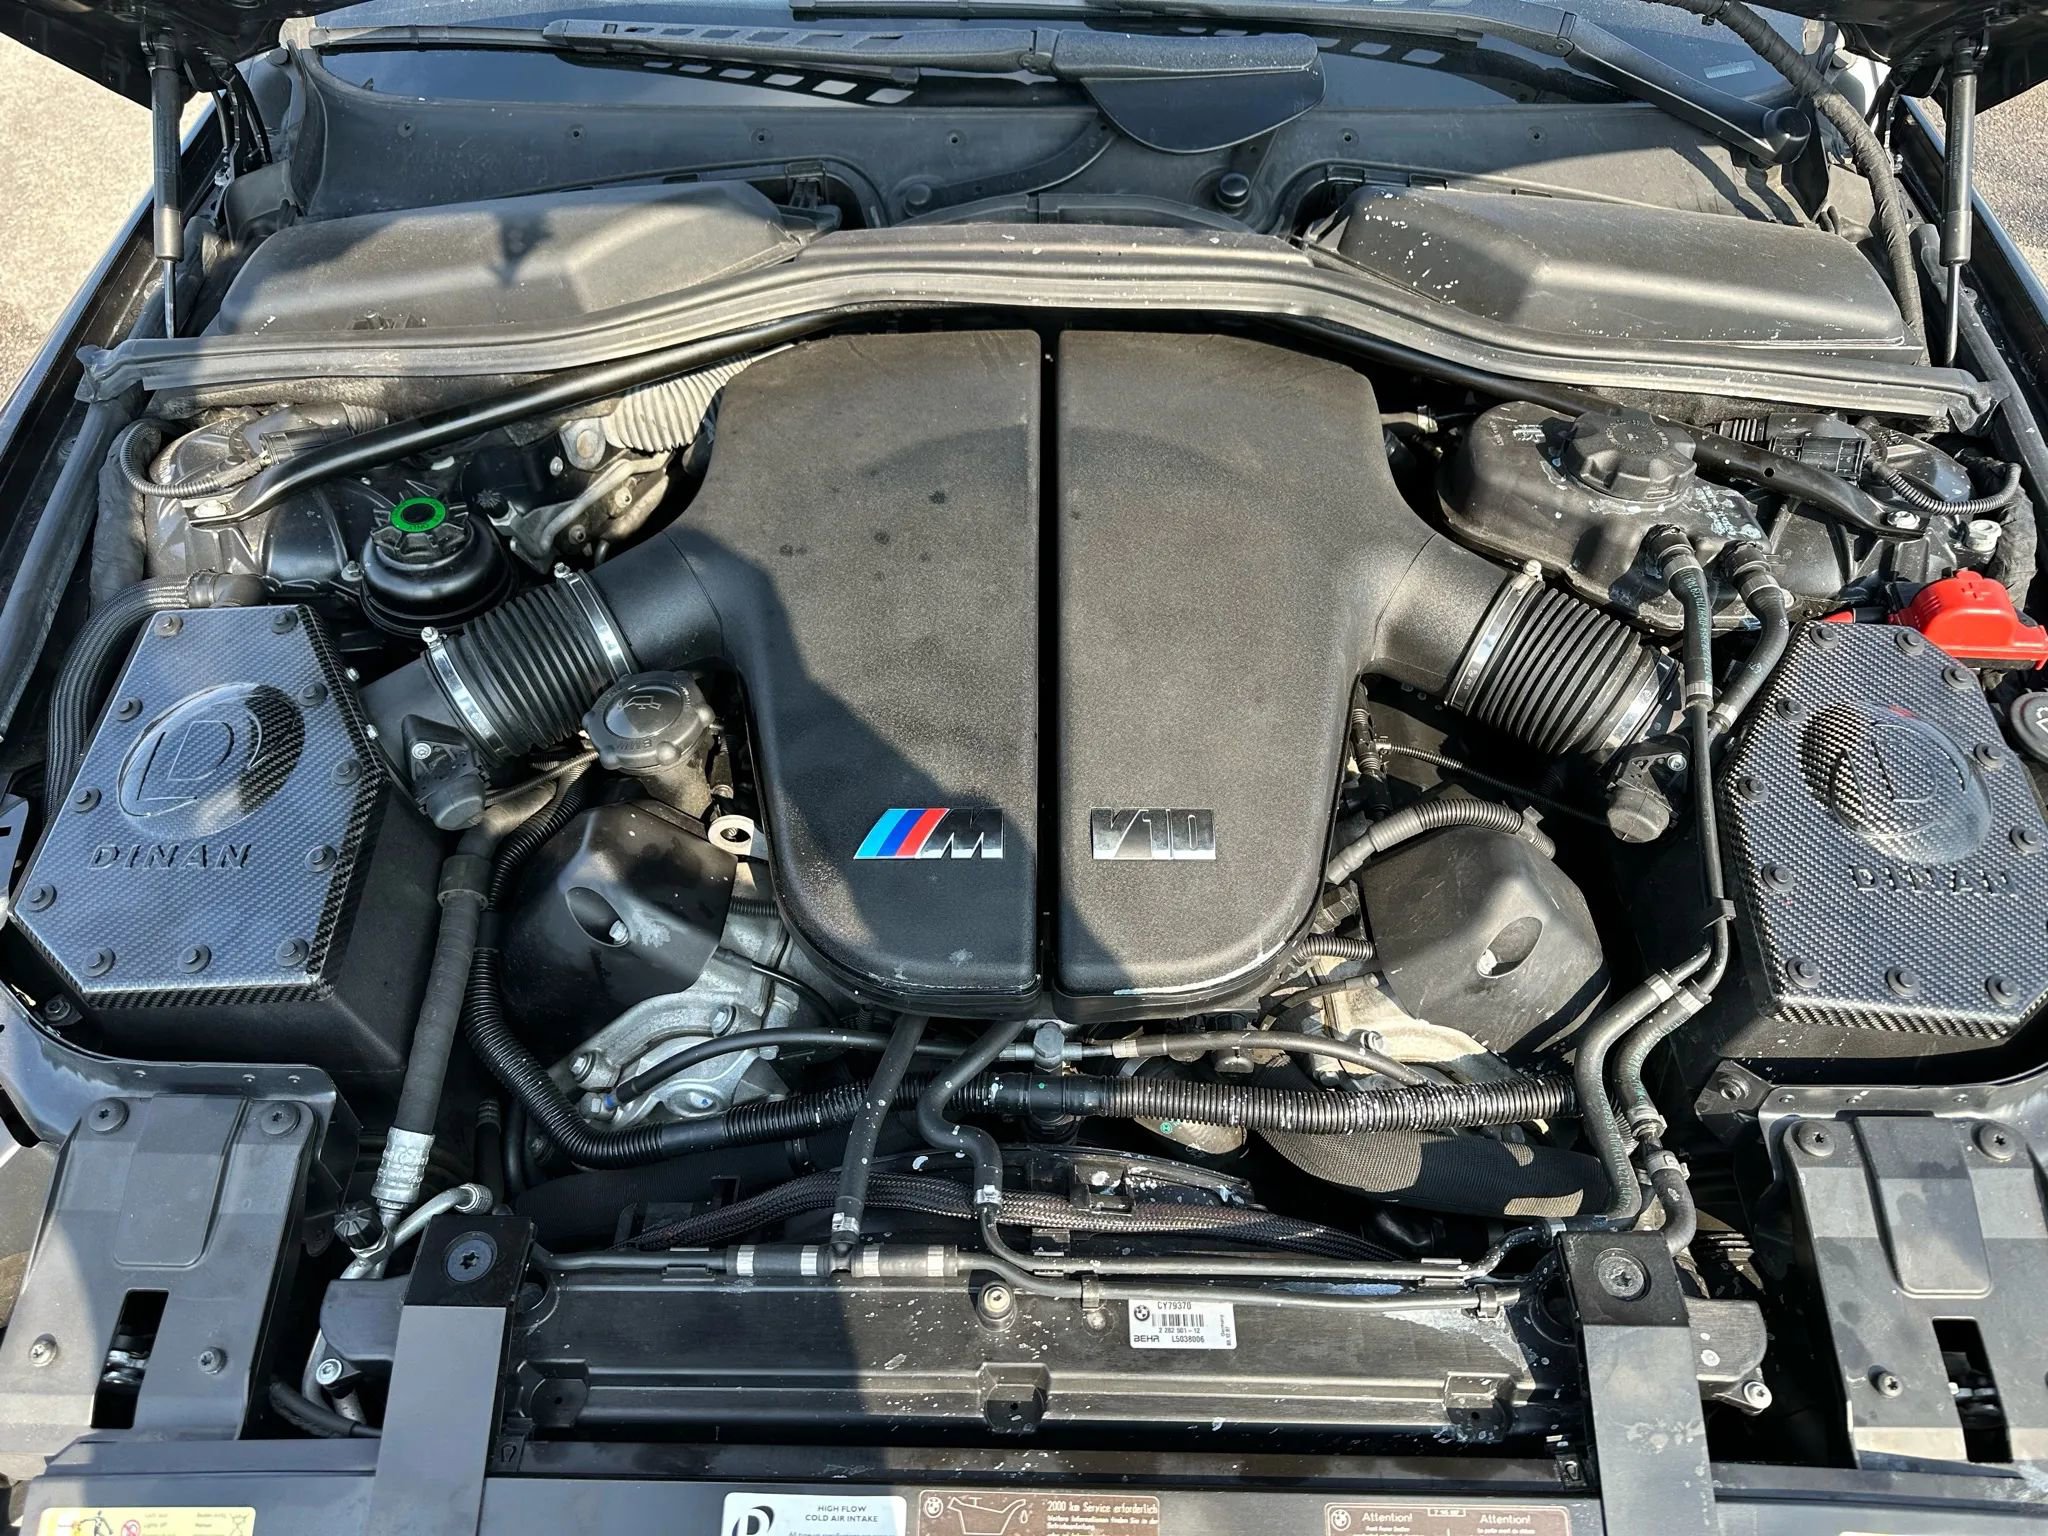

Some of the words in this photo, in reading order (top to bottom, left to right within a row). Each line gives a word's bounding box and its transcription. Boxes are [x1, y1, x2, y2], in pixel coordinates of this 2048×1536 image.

[915, 808, 1004, 860] M
[1091, 806, 1217, 860] V10
[88, 844, 252, 869] DINAN
[1848, 864, 2019, 898] DINAN
[1157, 1301, 1193, 1310] CY79370
[1133, 1335, 1160, 1343] BEHR
[1047, 1500, 1066, 1511] 2000
[1068, 1501, 1080, 1512] km
[1082, 1501, 1111, 1513] Service
[1113, 1503, 1158, 1514] erforderlich
[847, 1515, 879, 1523] INTAKE
[1361, 1511, 1413, 1523] Attention!
[1480, 1514, 1531, 1524] Attention!
